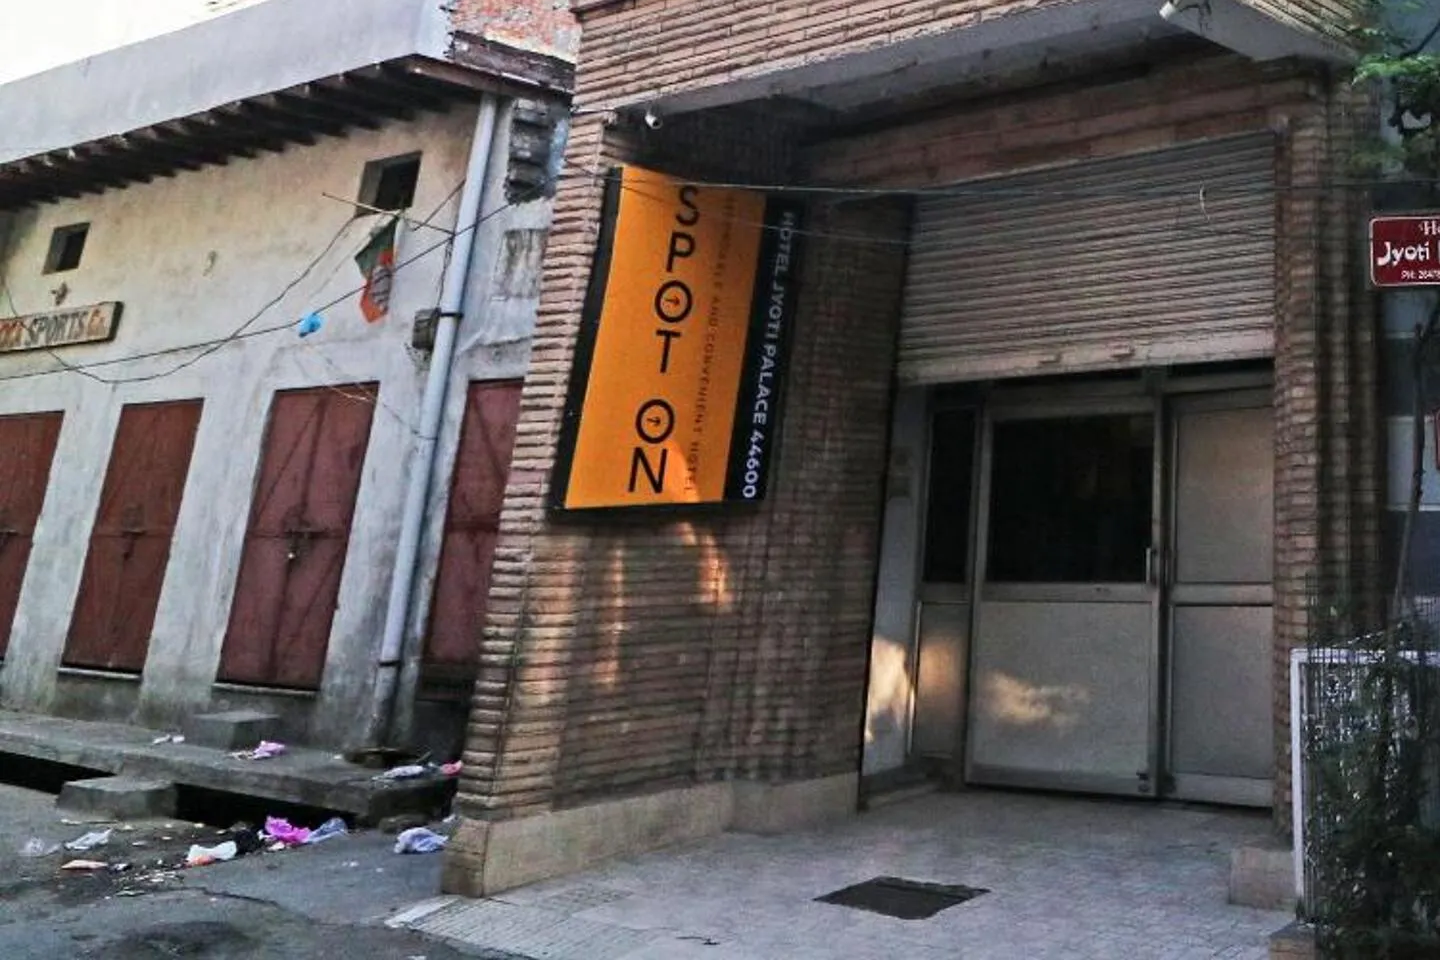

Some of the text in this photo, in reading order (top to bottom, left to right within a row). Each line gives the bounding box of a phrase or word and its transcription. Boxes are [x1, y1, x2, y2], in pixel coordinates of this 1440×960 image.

[24, 311, 88, 346] SPORTS
[1376, 241, 1430, 266] Jyoti
[628, 185, 699, 493] SPOT ON
[742, 211, 795, 499] HOTEL JYOTI PALACE 44600
